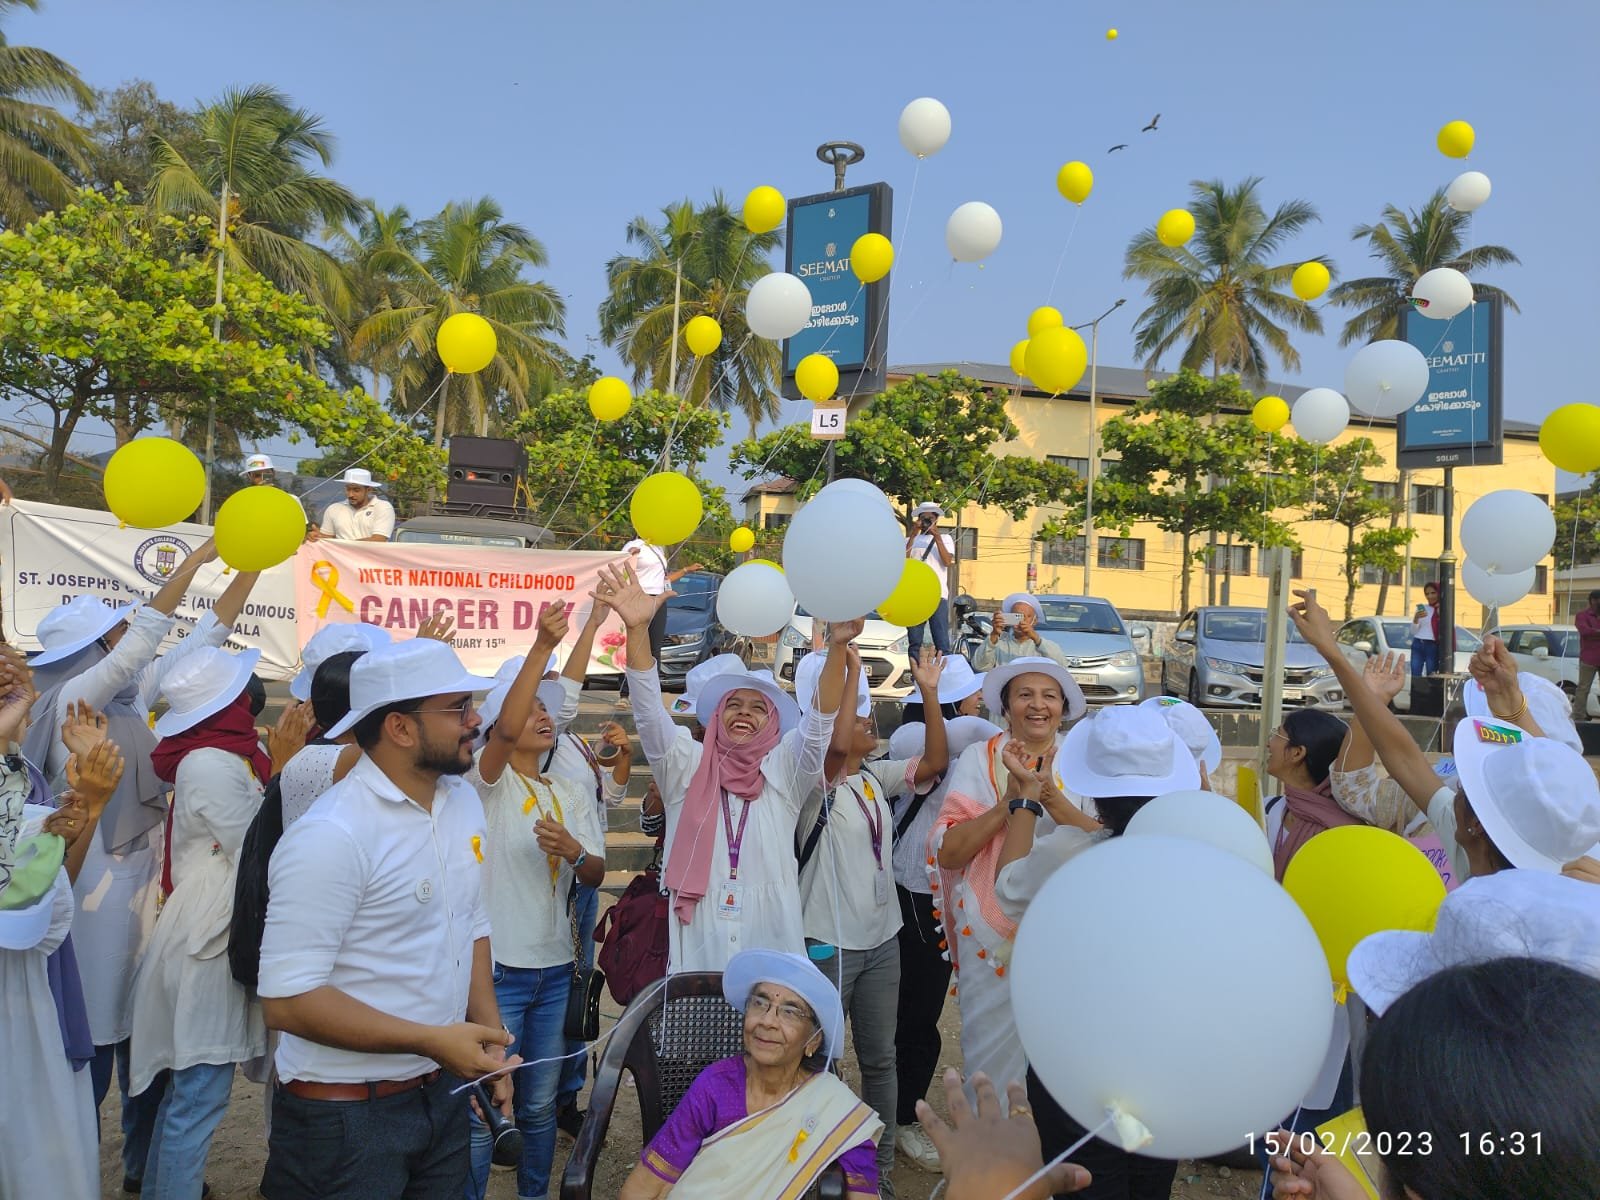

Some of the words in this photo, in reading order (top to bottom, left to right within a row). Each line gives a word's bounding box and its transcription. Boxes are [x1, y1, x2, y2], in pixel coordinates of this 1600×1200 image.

[797, 258, 851, 277] SEEMAT
[1425, 352, 1486, 369] EEMATTI
[819, 413, 839, 428] L5
[18, 572, 41, 585] ST.
[47, 573, 120, 591] JOSEPH'S
[358, 568, 402, 586] INTER
[408, 569, 482, 588] NATIONAL
[489, 573, 575, 591] CHILDHOOD
[360, 595, 499, 630] CANCER
[449, 638, 482, 649] RUARY
